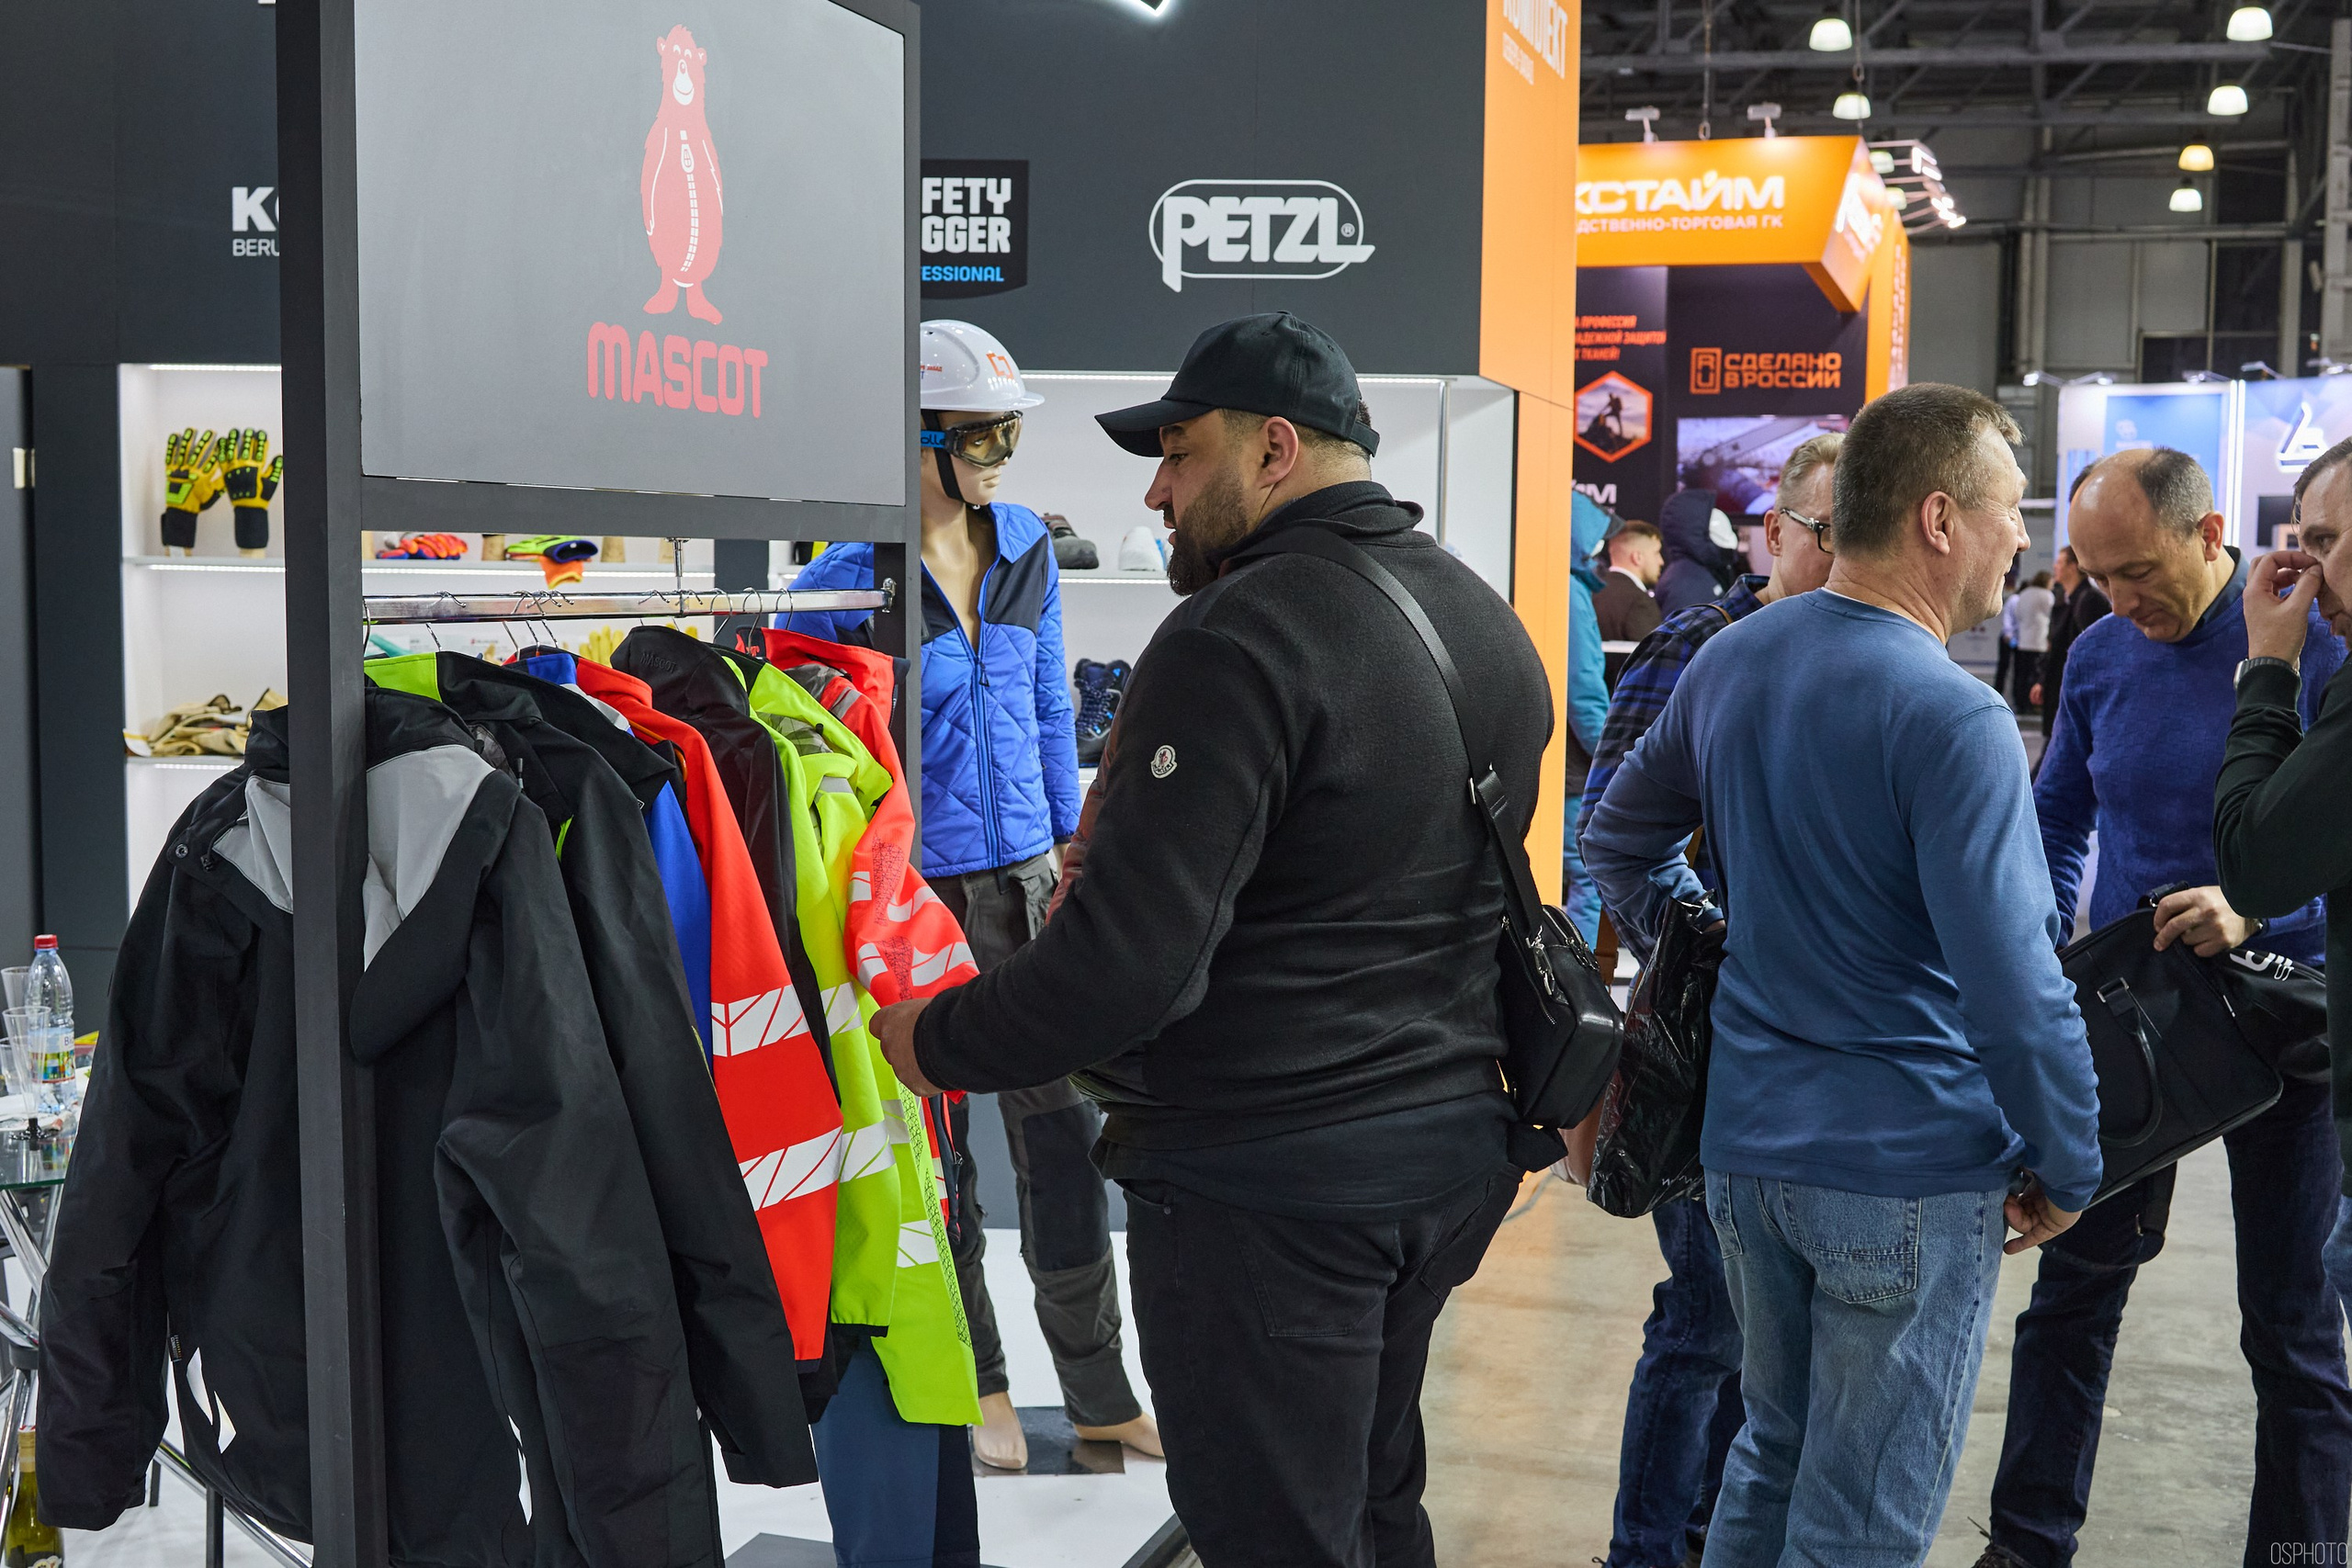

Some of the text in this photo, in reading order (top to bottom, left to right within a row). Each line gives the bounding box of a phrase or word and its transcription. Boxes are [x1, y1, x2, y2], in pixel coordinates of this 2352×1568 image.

[232, 186, 279, 232] K
[922, 177, 1012, 215] FETY
[921, 215, 1012, 254] GGER
[1761, 213, 1784, 230] ГК
[1162, 196, 1376, 293] PETZL
[921, 265, 1005, 283] ESSIONAL
[586, 321, 769, 419] MASCOT
[1724, 352, 1842, 371] СДЕЛАНО
[1742, 370, 1842, 389] РОССИИ
